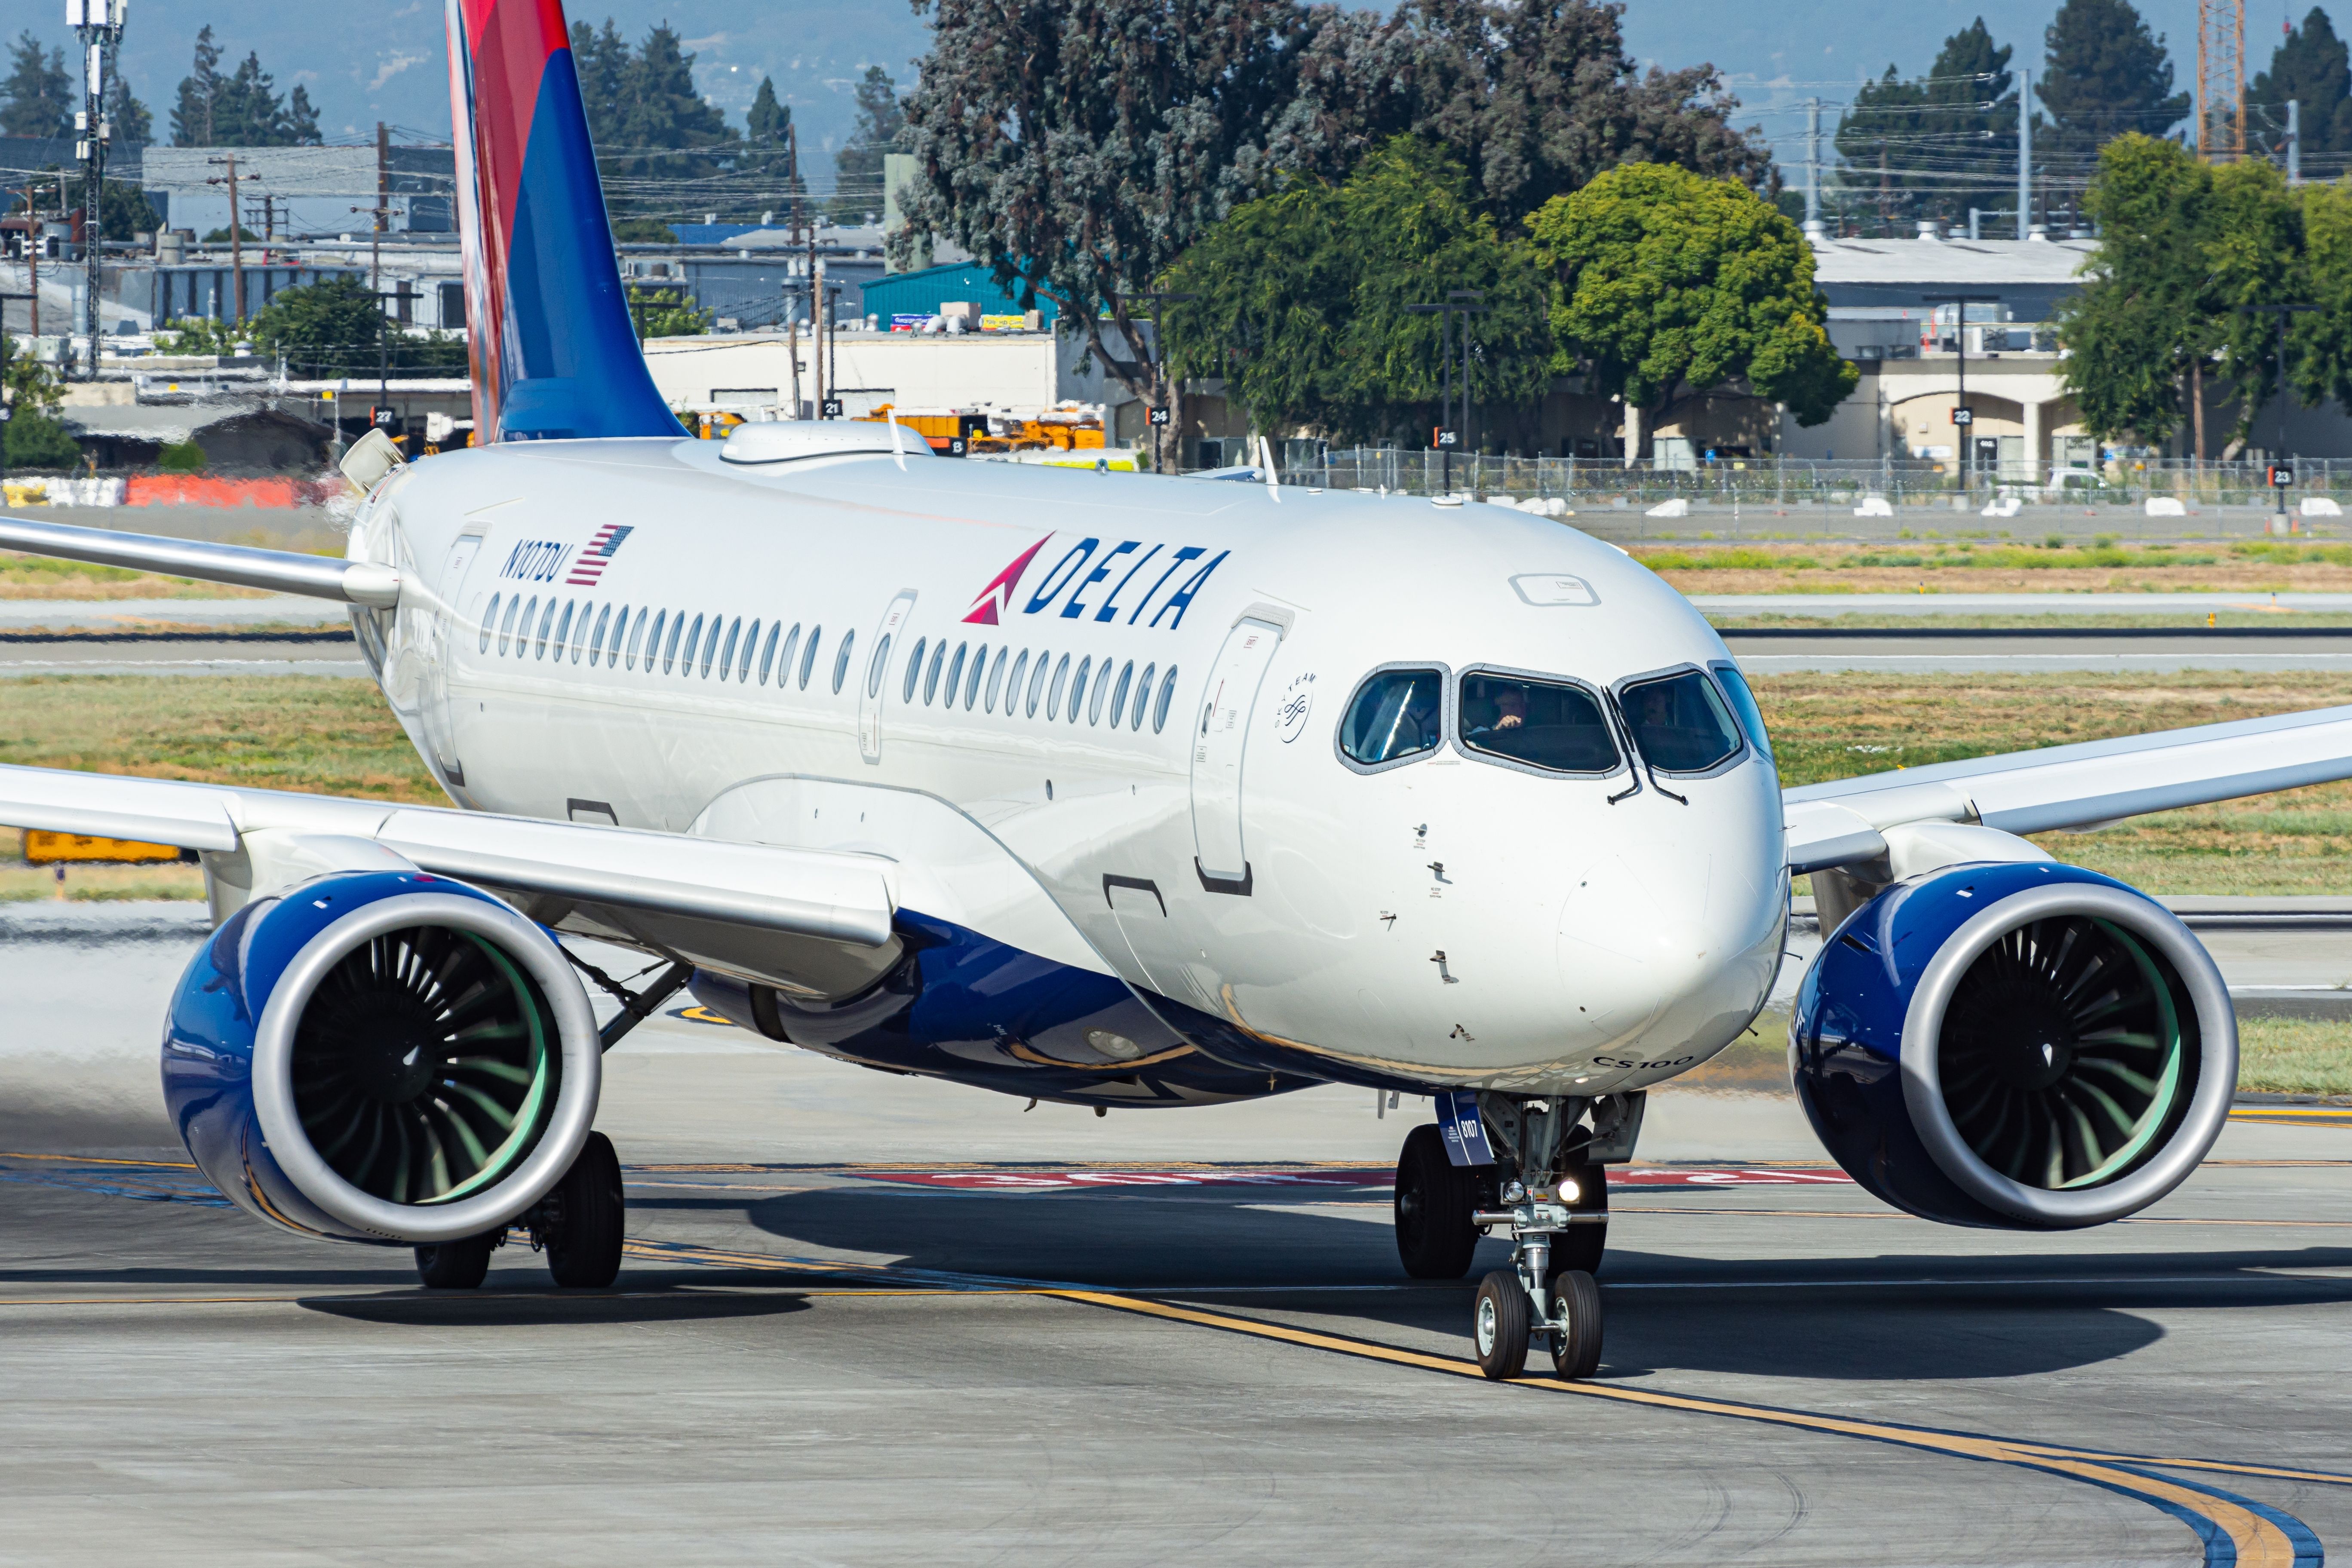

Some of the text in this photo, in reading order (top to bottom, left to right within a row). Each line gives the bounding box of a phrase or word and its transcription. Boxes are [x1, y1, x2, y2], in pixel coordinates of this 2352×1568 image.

[825, 402, 838, 414] 21
[376, 411, 392, 422] 27
[1151, 411, 1167, 421] 24
[1954, 411, 1971, 423] 22
[1440, 432, 1456, 443] 25
[2275, 471, 2291, 483] 23
[499, 539, 574, 583] N107DU
[1022, 537, 1231, 630] DELTA
[1593, 1056, 1694, 1069] CS100
[1461, 1120, 1477, 1138] 8107
